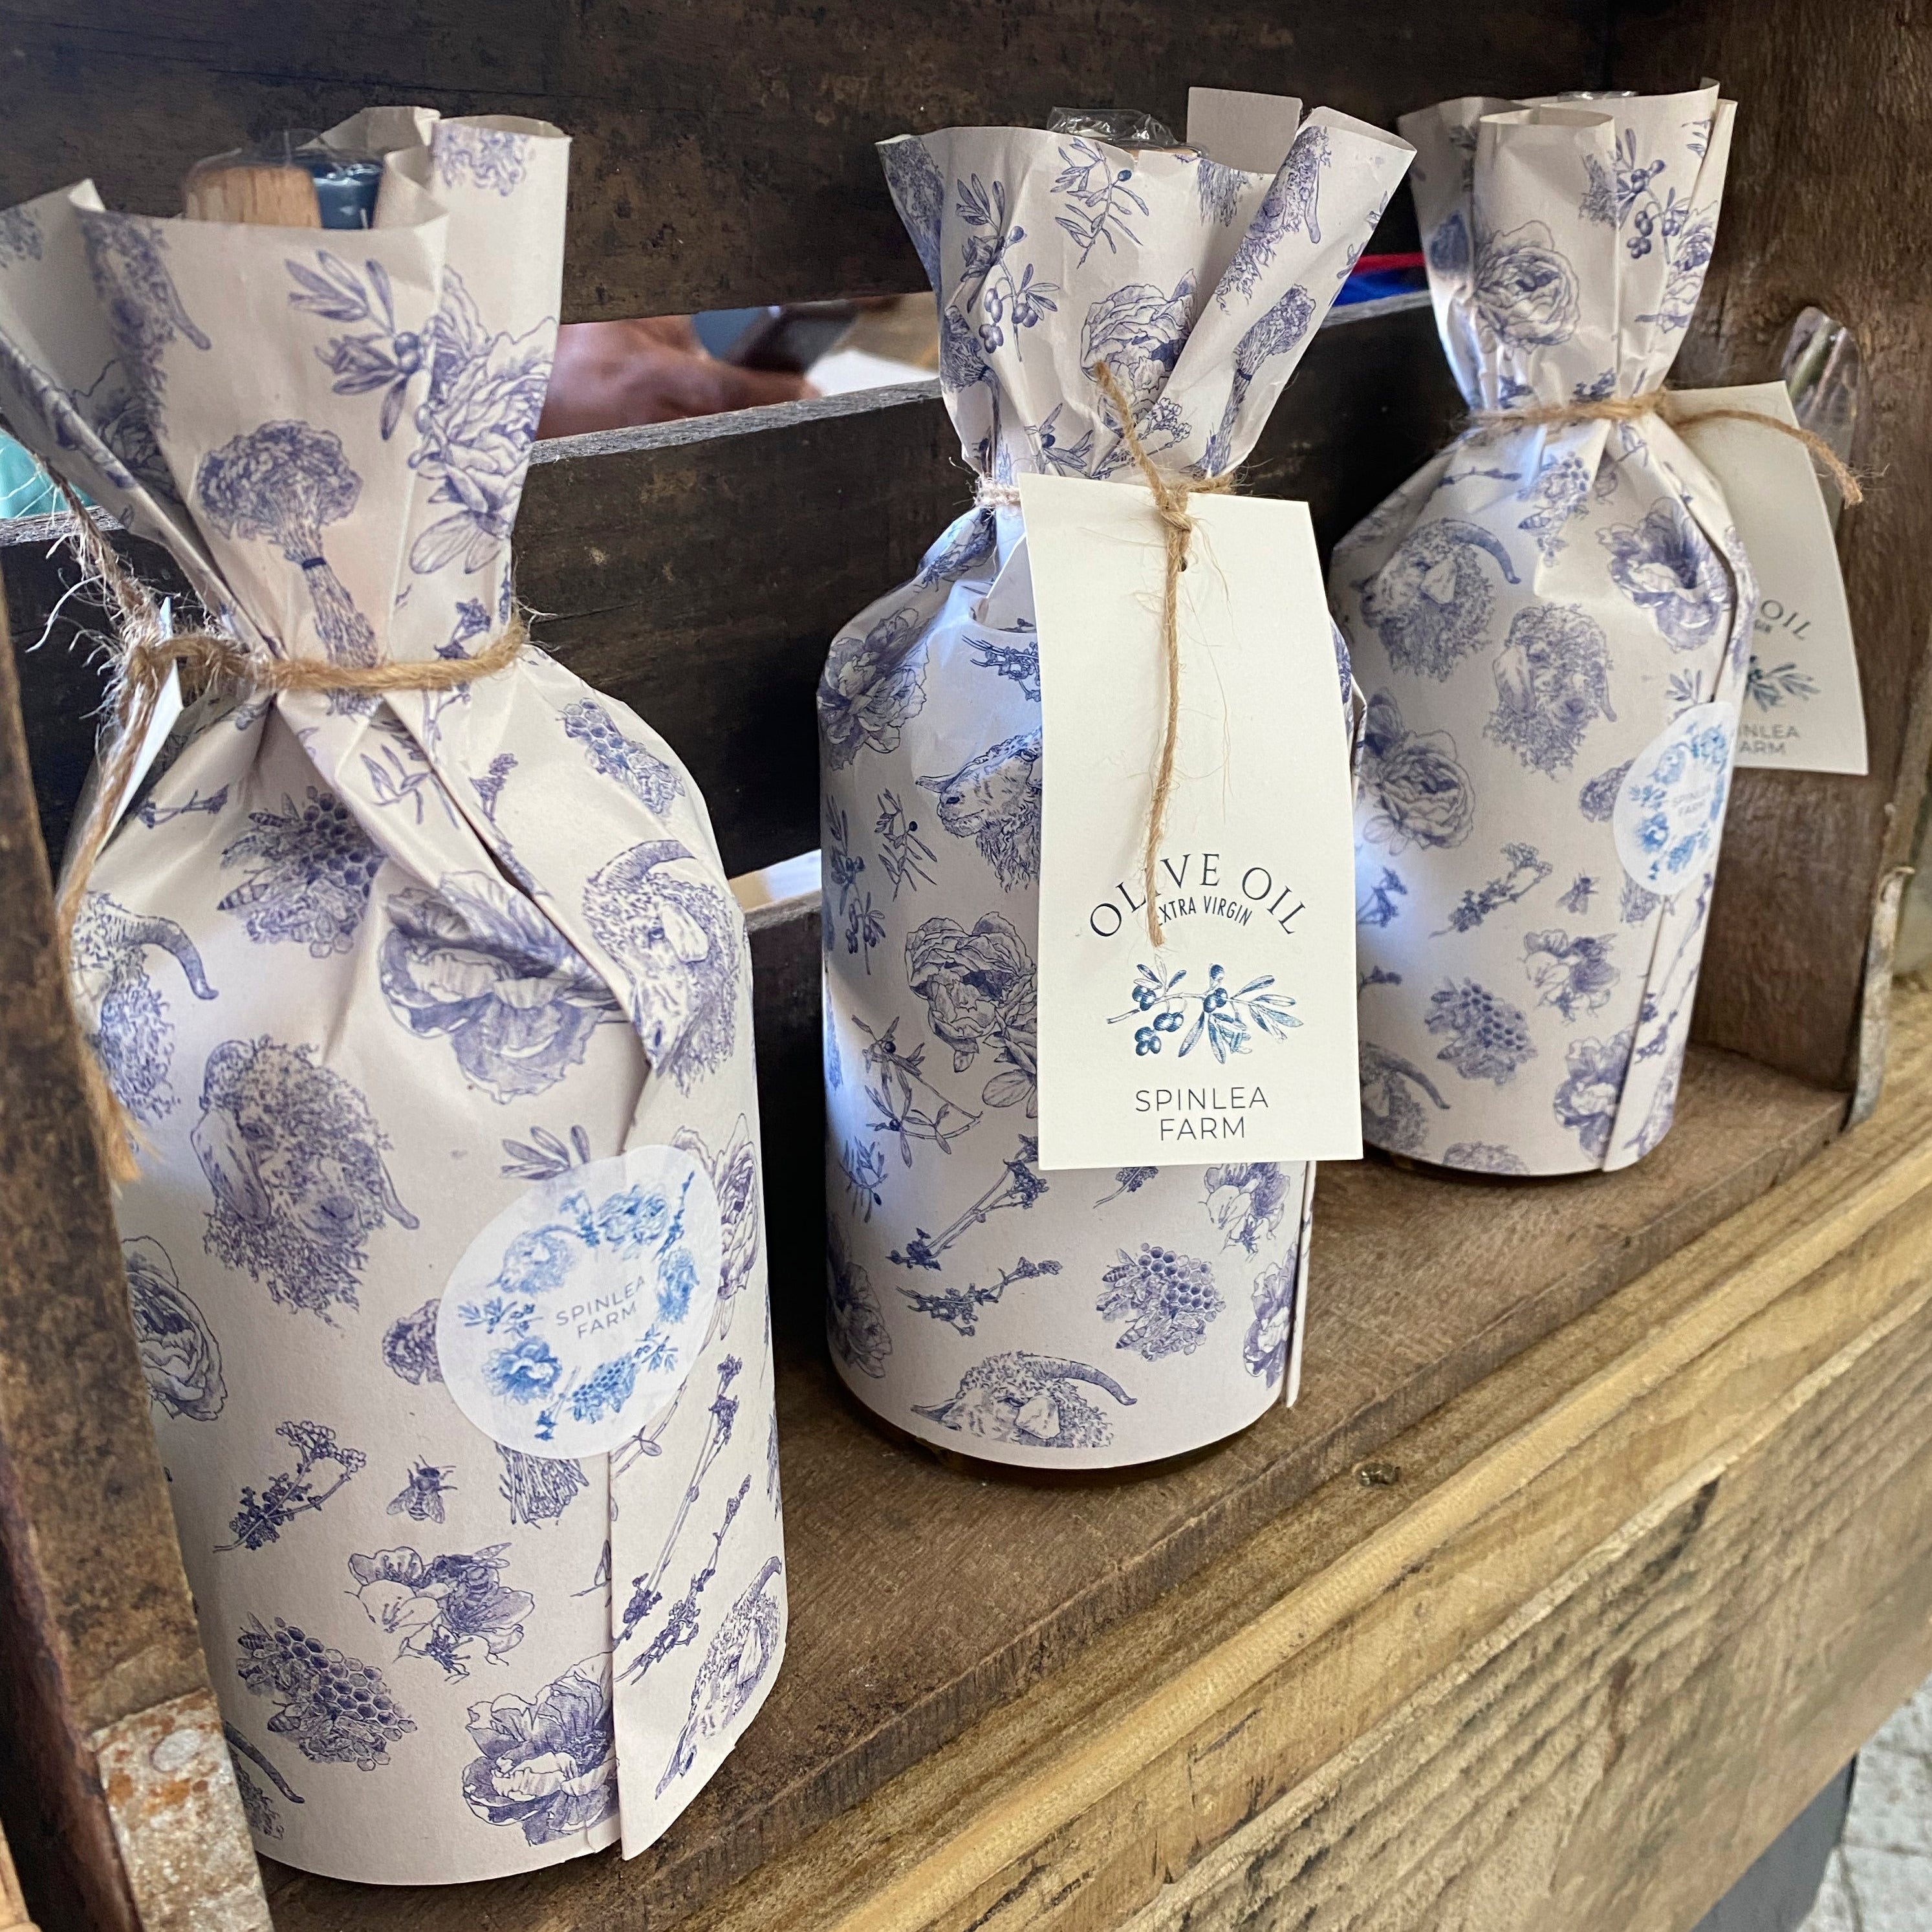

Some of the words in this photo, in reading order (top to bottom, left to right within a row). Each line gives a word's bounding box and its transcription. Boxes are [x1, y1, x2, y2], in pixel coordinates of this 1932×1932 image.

[1761, 599, 1810, 640] OIL
[1738, 740, 1786, 755] ARM
[1090, 853, 1221, 937] OLVE
[1241, 867, 1306, 935] OIL
[1158, 896, 1197, 926] XTRA
[1203, 895, 1253, 927] VIRGIN
[1135, 1086, 1268, 1112] SPINLEA
[1160, 1116, 1244, 1141] FARM
[556, 1275, 645, 1327] SPINLEA
[577, 1300, 636, 1339] FARM
